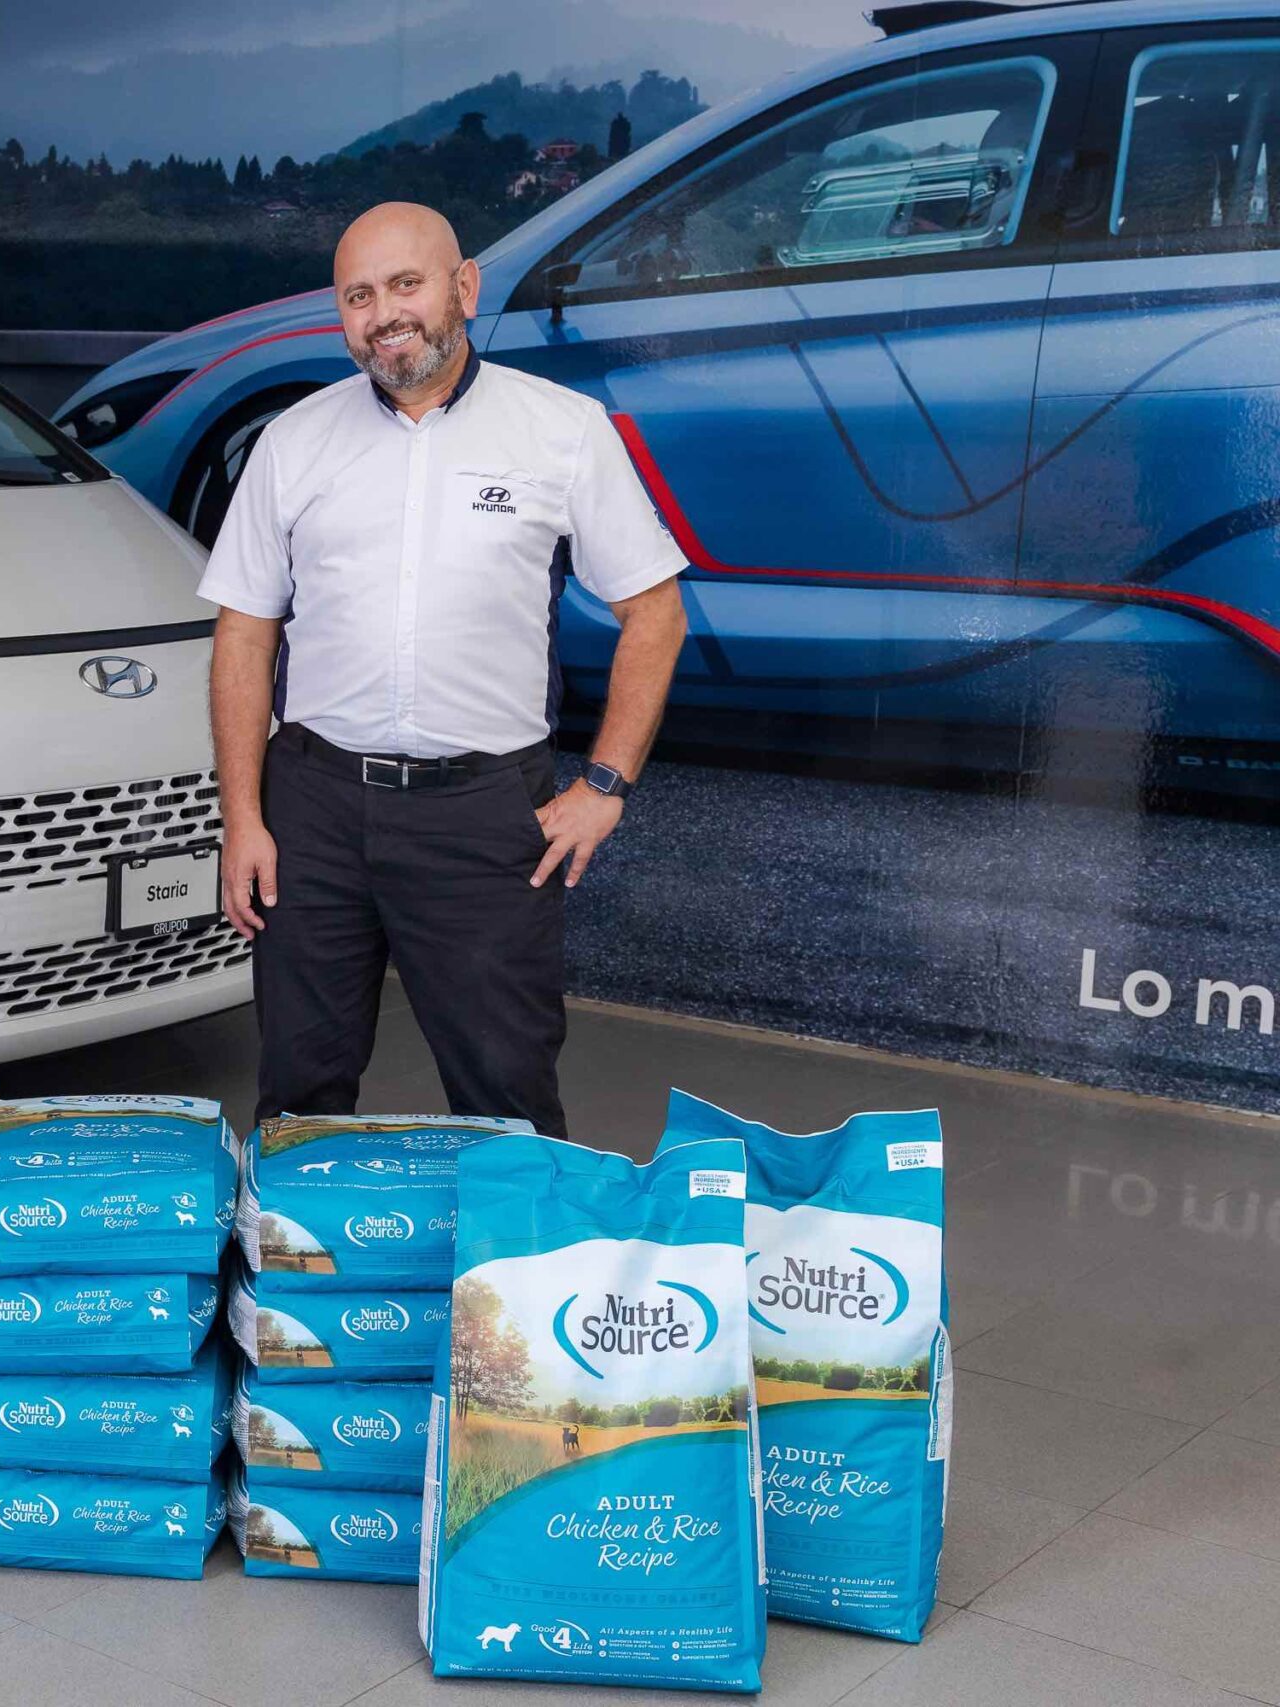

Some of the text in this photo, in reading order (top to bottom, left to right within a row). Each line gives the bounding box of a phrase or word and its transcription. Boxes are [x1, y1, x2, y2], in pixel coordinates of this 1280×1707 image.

[472, 502, 517, 514] HYUNDAI
[147, 880, 188, 902] Staria
[1079, 948, 1172, 1018] Lo
[900, 1159, 919, 1167] USA
[102, 1194, 138, 1204] ADULT
[19, 1205, 51, 1217] Nutri
[80, 1203, 160, 1217] Chicken & Rice
[10, 1214, 57, 1228] Source
[103, 1216, 140, 1230] Recipe
[363, 1215, 397, 1228] Nutri
[355, 1225, 403, 1239] Source
[783, 1256, 866, 1293] Nutri
[76, 1290, 112, 1299] ADULT
[757, 1275, 879, 1320] Source
[54, 1298, 134, 1313] Chicken & Rice
[603, 1293, 675, 1328] Nutri
[77, 1312, 113, 1326] Recipe
[360, 1308, 393, 1320] Nutri
[423, 1309, 448, 1322] Chic
[351, 1318, 400, 1332] Source
[581, 1315, 690, 1355] Source
[18, 1402, 50, 1415] Nutri
[101, 1400, 137, 1410] ADULT
[9, 1412, 55, 1426] Source
[79, 1409, 160, 1423] Chicken & Rice
[352, 1415, 385, 1428] Nutri
[100, 1421, 137, 1435] Recipe
[343, 1425, 390, 1440] Source
[766, 1445, 846, 1468] ADULT
[761, 1462, 892, 1498] cken & Rice
[12, 1499, 44, 1513] Nutri
[95, 1499, 130, 1508] ADULT
[597, 1495, 676, 1512] ADULT
[764, 1490, 843, 1525] Recipe
[3, 1509, 48, 1524] Source
[73, 1507, 152, 1522] Chicken & Rice
[350, 1514, 382, 1528] Nutri
[94, 1520, 129, 1534] Recipe
[341, 1524, 387, 1540] Source
[546, 1513, 722, 1544] Chicken & Rice
[597, 1543, 678, 1576] Recipe
[779, 1569, 816, 1580] Aspects
[818, 1574, 829, 1583] of
[839, 1577, 876, 1587] Healthy
[531, 1623, 556, 1634] Good
[600, 1627, 615, 1635] All
[617, 1627, 655, 1637] Aspects
[657, 1628, 668, 1636] of
[679, 1627, 715, 1638] Healthy
[716, 1626, 734, 1635] Life
[552, 1627, 571, 1649] 4
[572, 1643, 593, 1651] Life
